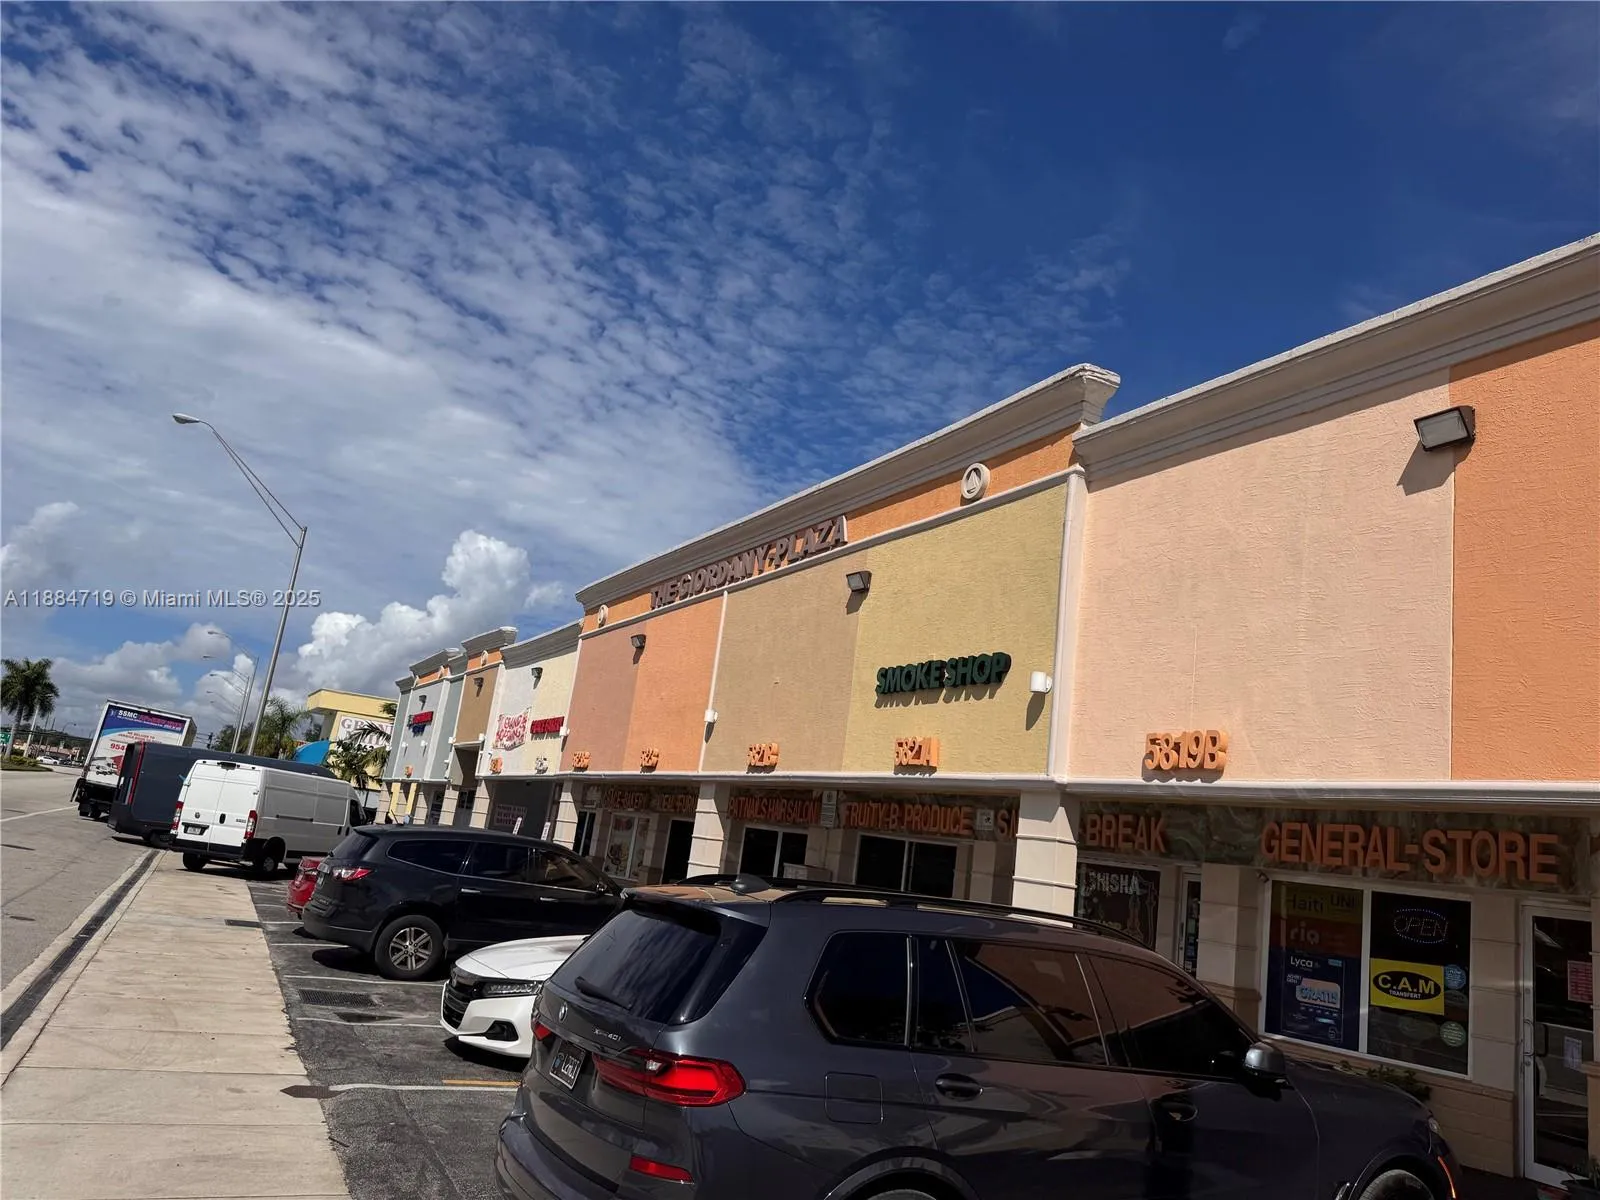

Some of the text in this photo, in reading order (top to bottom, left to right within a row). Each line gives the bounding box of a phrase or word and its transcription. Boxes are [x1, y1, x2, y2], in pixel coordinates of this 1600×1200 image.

[876, 652, 1011, 695] SMOKE SHOP
[1143, 730, 1228, 772] 5819B
[903, 804, 974, 836] PRODUCE
[1084, 813, 1167, 854] BREAK
[1260, 820, 1559, 884] GENERAL-STORE
[1393, 915, 1449, 937] OPEN
[1290, 956, 1313, 968] Lyca
[1378, 973, 1436, 995] C.A.M
[1388, 989, 1422, 999] TRANSFERT
